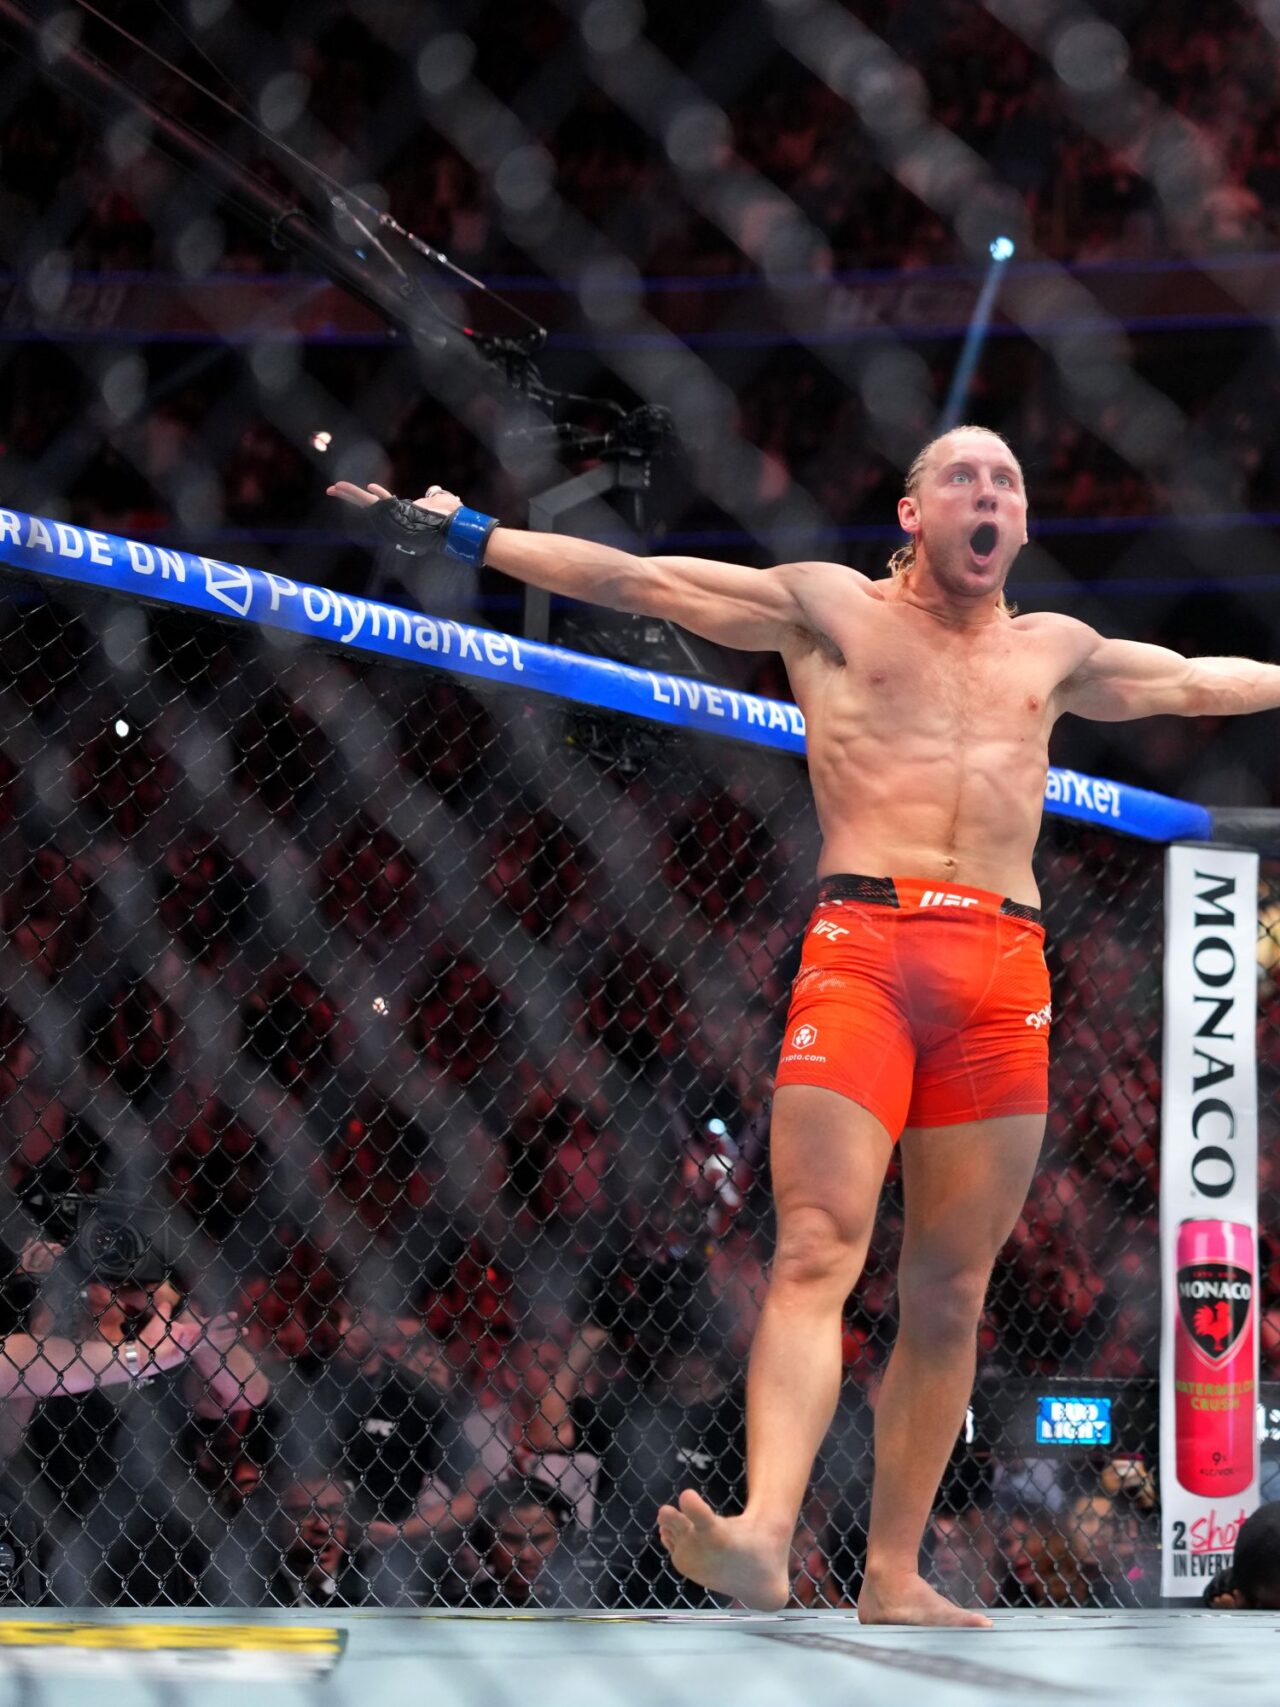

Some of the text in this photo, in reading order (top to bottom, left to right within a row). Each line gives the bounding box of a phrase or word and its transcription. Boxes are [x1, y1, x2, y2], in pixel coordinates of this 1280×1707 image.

[126, 540, 186, 582] ON
[261, 570, 524, 671] Polymarket
[1192, 869, 1236, 1199] MONACO
[1179, 1280, 1252, 1300] MONACO
[1051, 1402, 1099, 1422] BUD
[1172, 1520, 1187, 1550] 2
[1173, 1553, 1188, 1577] IN
